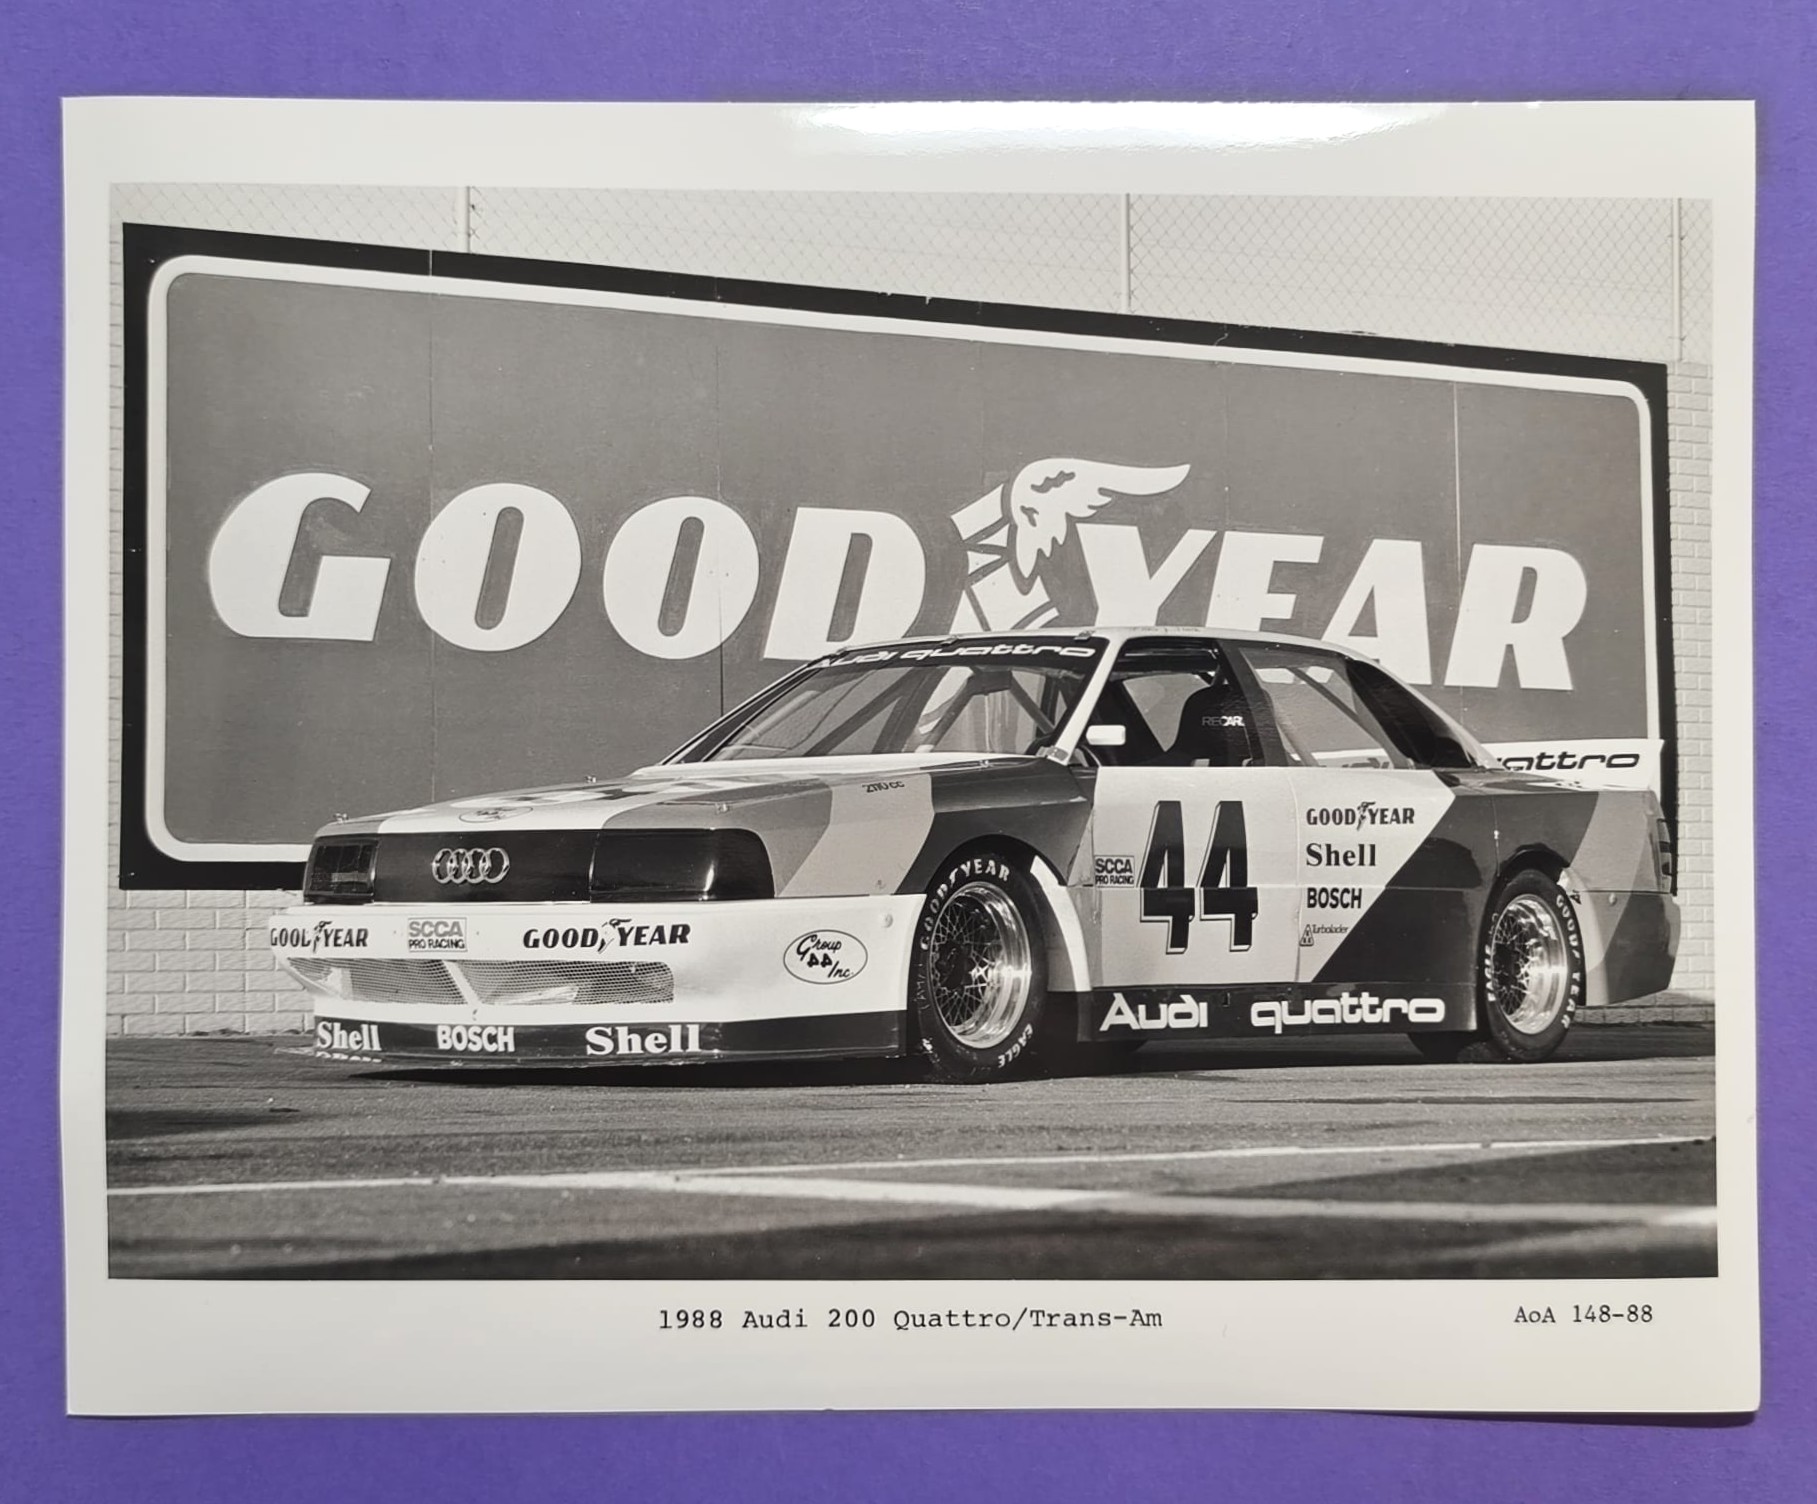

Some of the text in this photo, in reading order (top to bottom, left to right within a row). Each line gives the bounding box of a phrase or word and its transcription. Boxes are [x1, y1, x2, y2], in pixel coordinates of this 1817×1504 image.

[900, 643, 1096, 660] quattro
[1498, 751, 1640, 771] attro
[1095, 857, 1133, 874] SCCA
[1306, 843, 1377, 867] Shell
[1095, 875, 1134, 885] PRO RACING
[1137, 800, 1258, 954] 44
[1306, 887, 1363, 909] BOSCH
[408, 920, 464, 937] SCCA
[408, 938, 465, 949] PRO RACING
[796, 933, 842, 962] Group
[1100, 991, 1446, 1034] Audi quattro
[316, 1021, 382, 1051] Shell
[436, 1024, 516, 1053] BOSCH
[585, 1023, 701, 1056] Shell
[659, 1309, 723, 1330] 1988
[742, 1308, 809, 1329] Audi
[827, 1308, 876, 1329] 200
[1514, 1304, 1654, 1323] AoA 148-88
